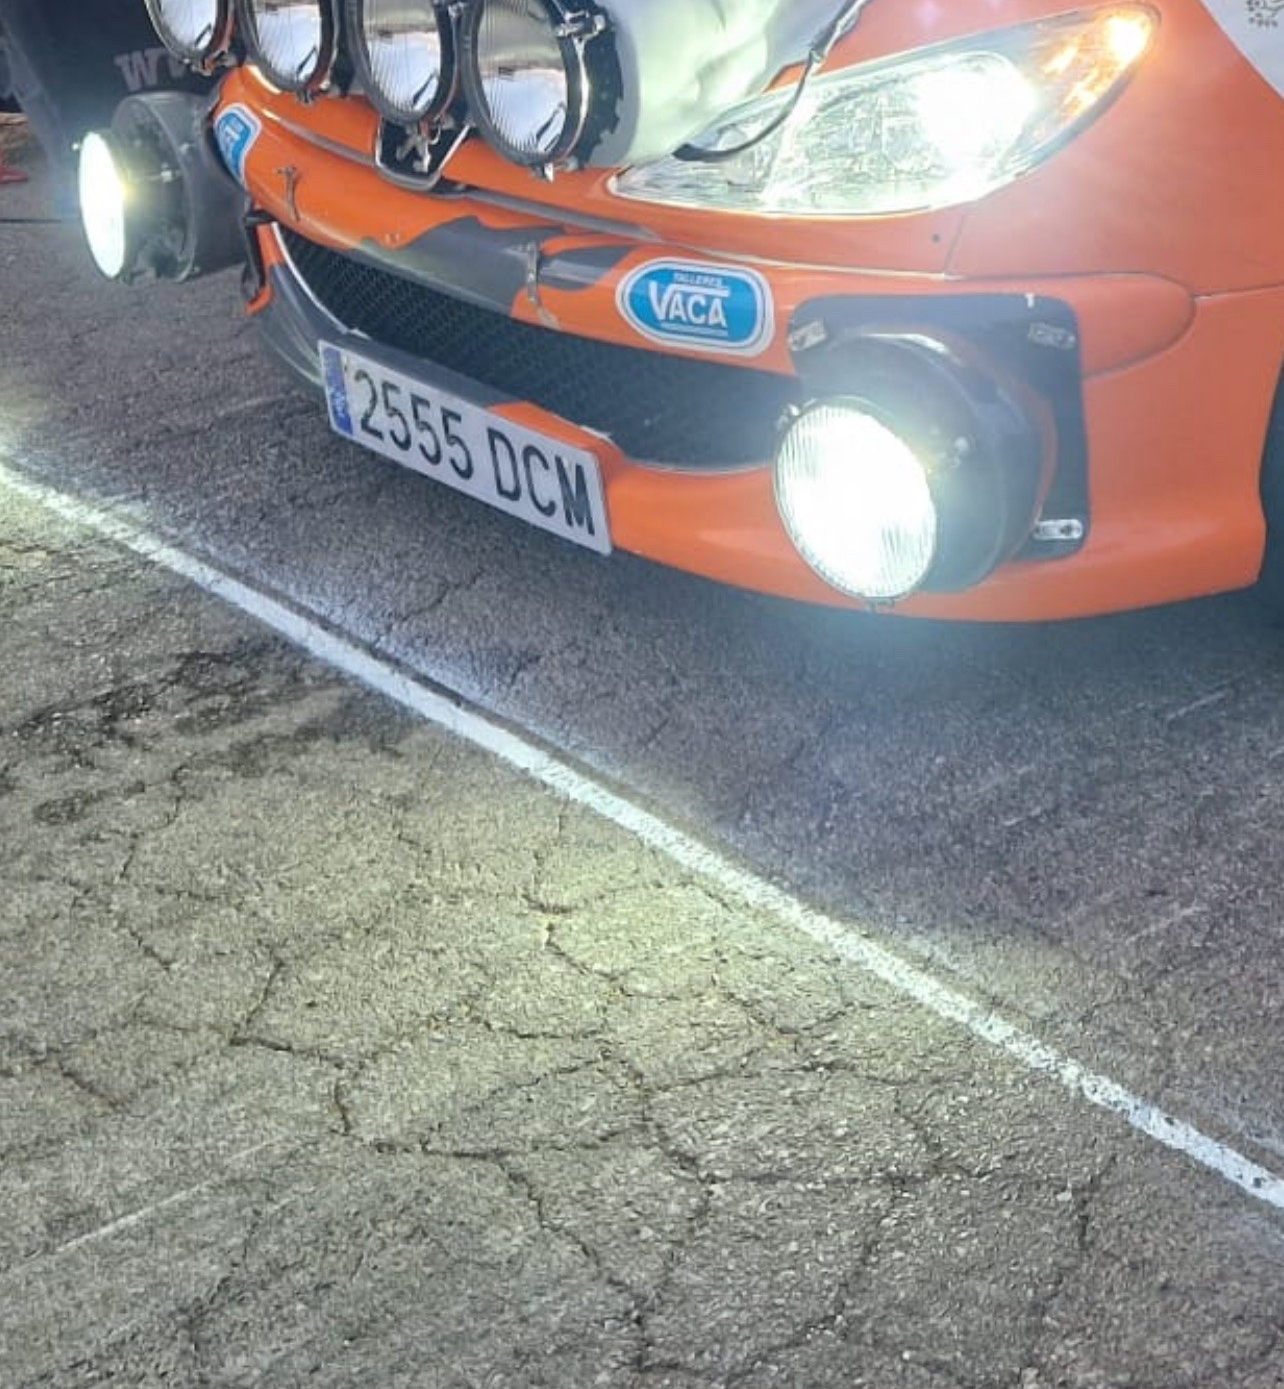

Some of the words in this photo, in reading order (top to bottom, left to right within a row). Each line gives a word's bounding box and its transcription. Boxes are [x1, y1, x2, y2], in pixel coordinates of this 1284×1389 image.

[649, 281, 730, 328] VACA
[354, 368, 474, 480] 2555
[487, 427, 596, 536] DCM
